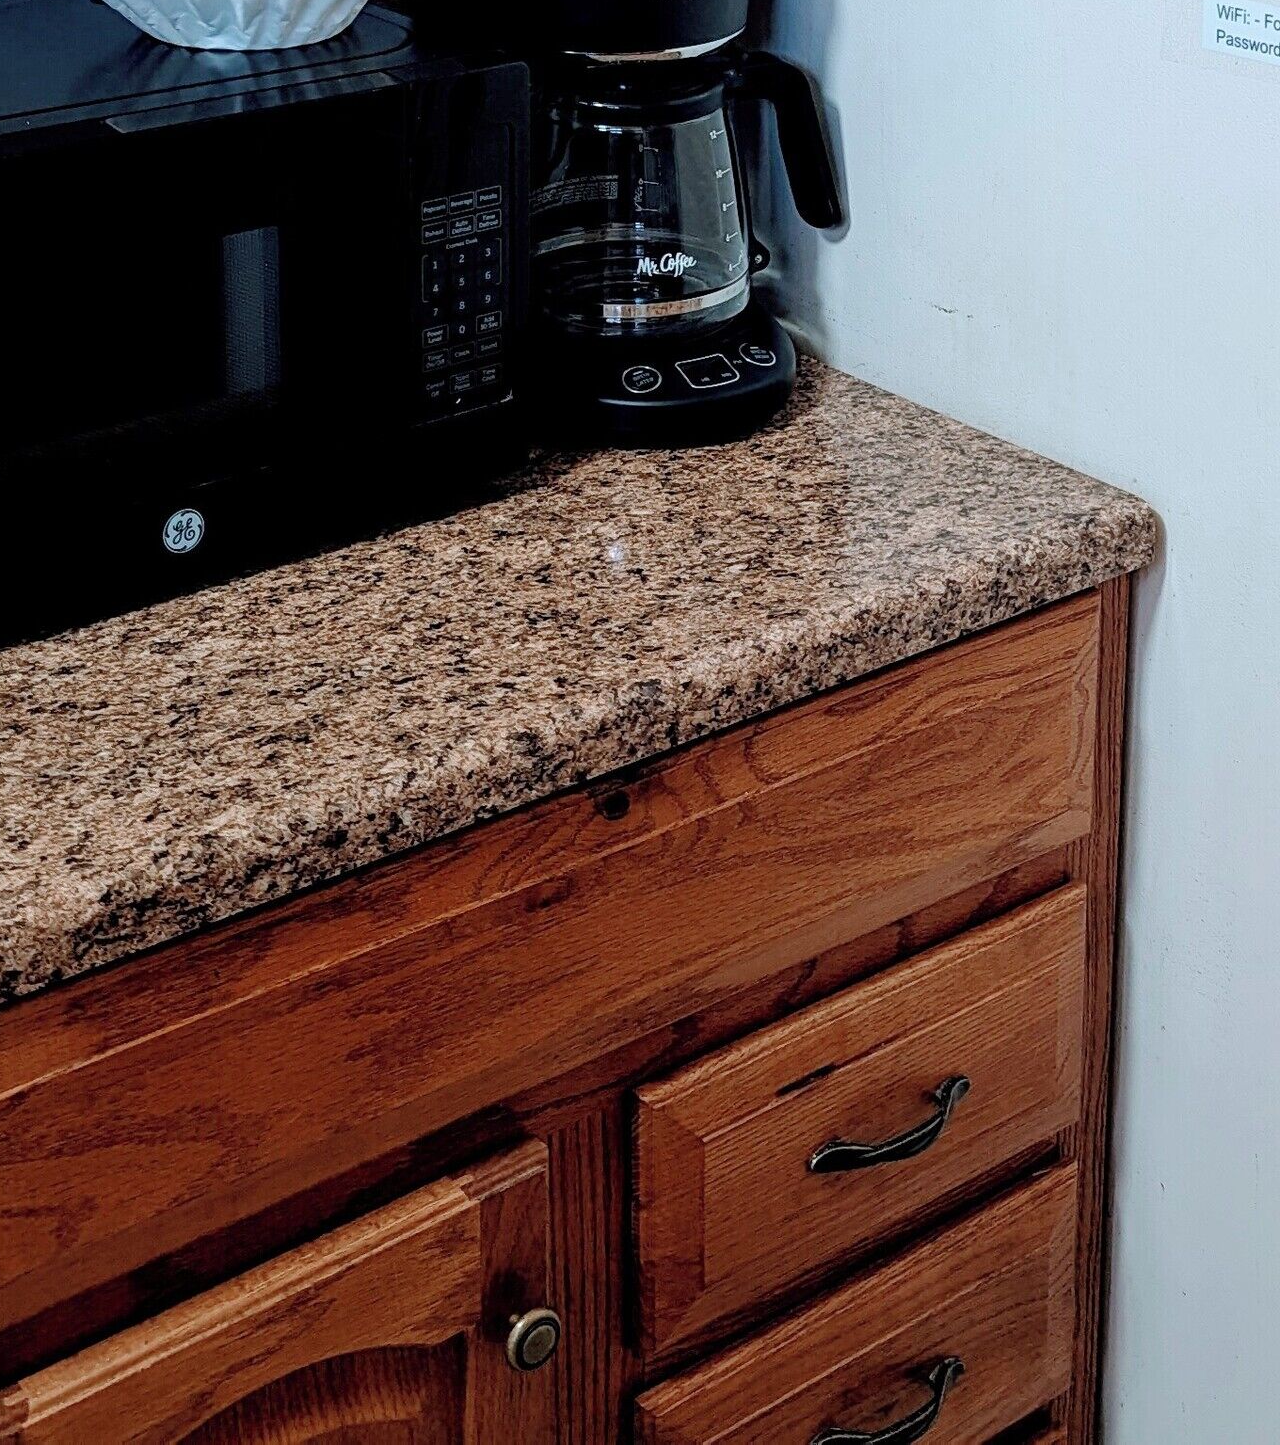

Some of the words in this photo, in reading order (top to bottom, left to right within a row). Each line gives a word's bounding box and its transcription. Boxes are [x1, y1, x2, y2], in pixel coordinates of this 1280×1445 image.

[1216, 3, 1250, 25] WiFi:
[433, 261, 437, 269] 1
[459, 254, 465, 263] 2
[485, 248, 491, 257] 3
[636, 257, 660, 277] Mr.
[660, 252, 697, 277] Coffee
[459, 278, 465, 286] 5
[485, 271, 491, 279] 6
[433, 308, 438, 316] 7
[485, 295, 491, 303] 9
[459, 325, 465, 333] 0
